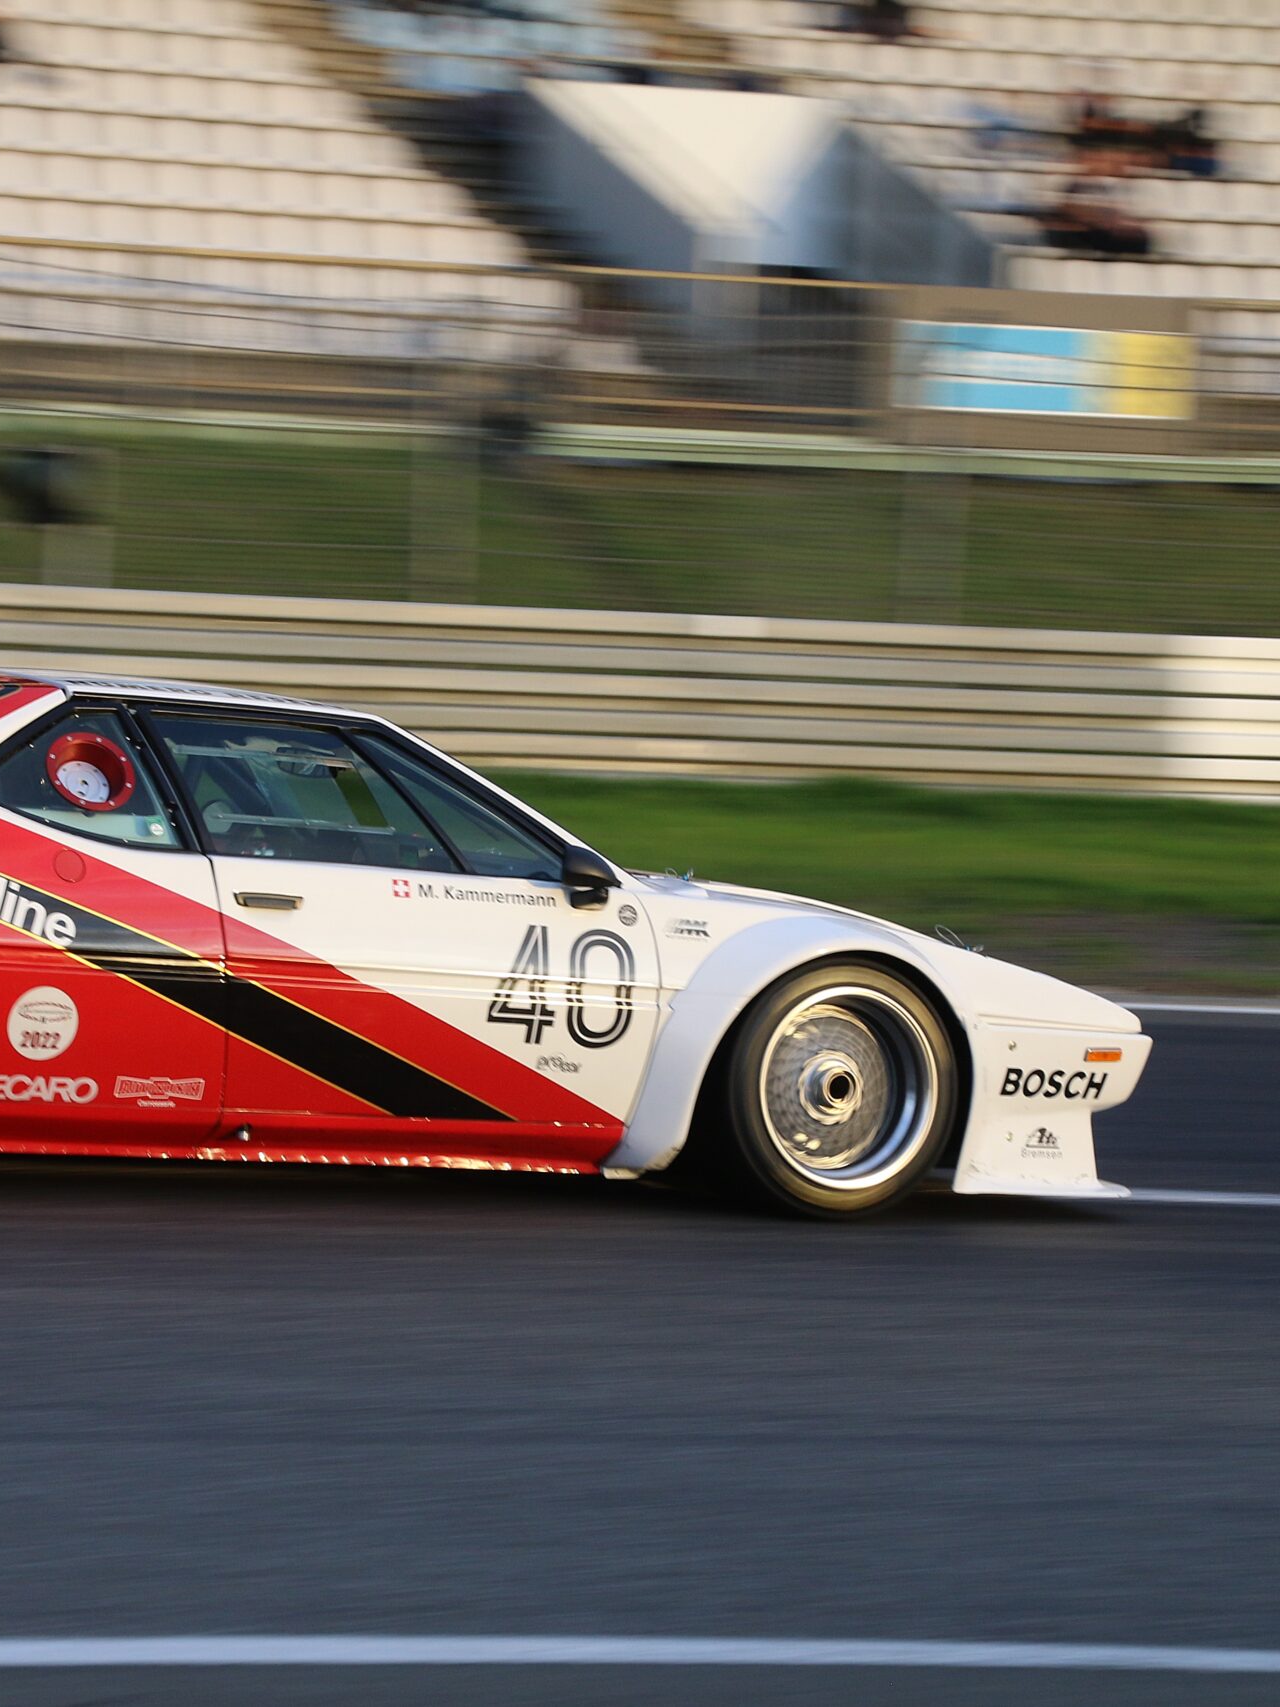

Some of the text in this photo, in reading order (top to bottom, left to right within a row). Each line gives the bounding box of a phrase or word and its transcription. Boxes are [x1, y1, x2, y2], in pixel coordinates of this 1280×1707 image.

[417, 883, 558, 907] M. Kammermann
[487, 924, 637, 1049] 40
[20, 1030, 61, 1050] 2022
[1000, 1068, 1108, 1100] BOSCH
